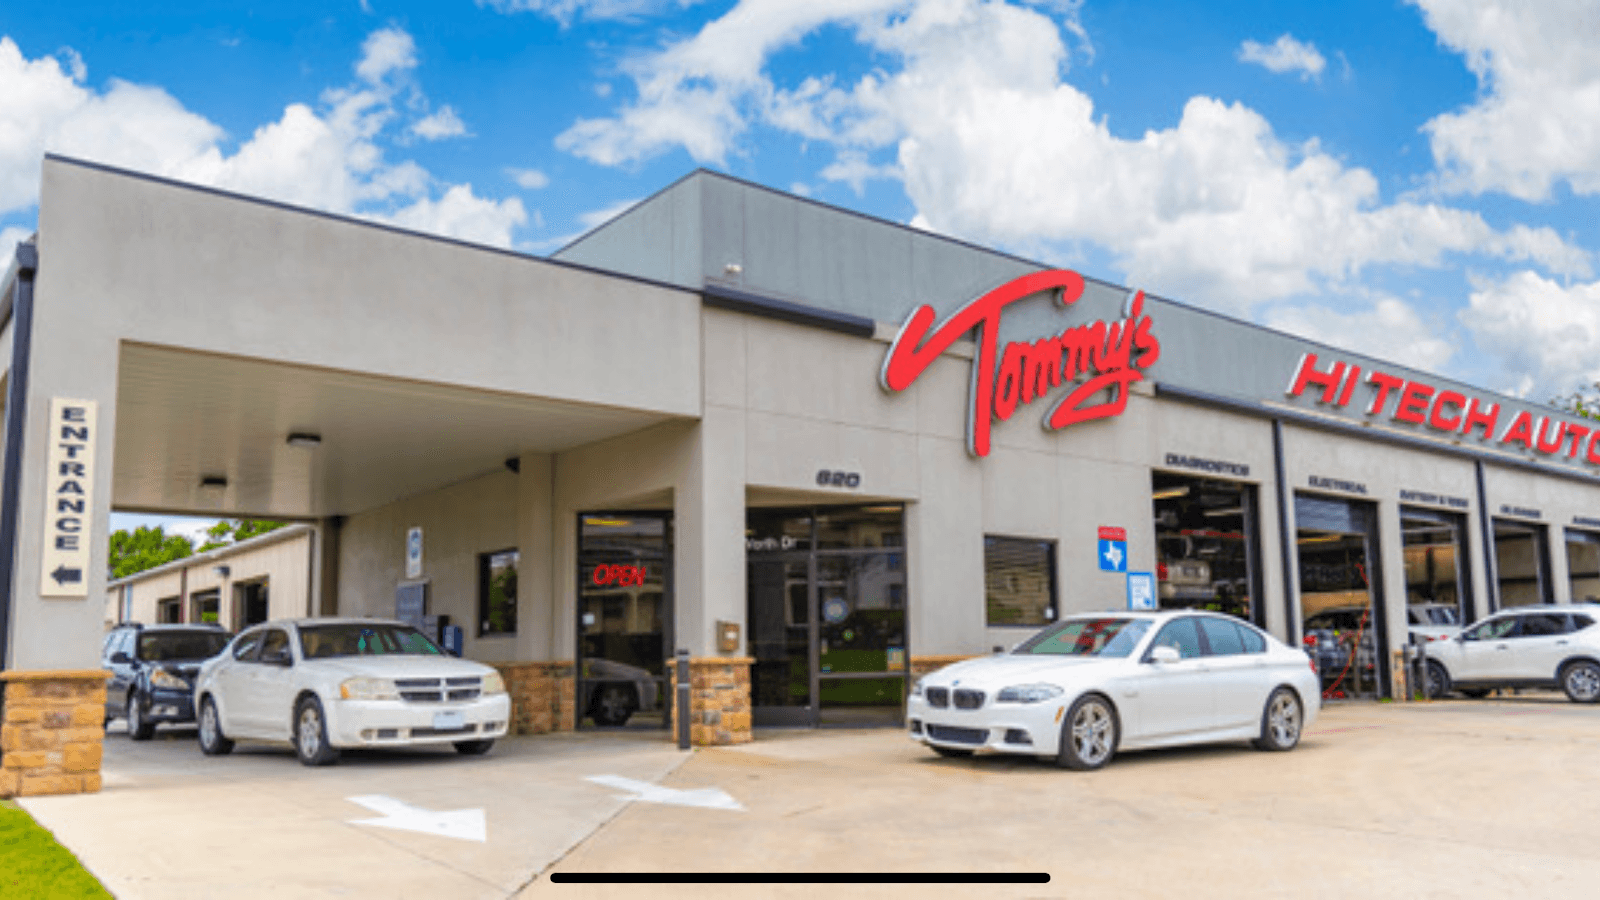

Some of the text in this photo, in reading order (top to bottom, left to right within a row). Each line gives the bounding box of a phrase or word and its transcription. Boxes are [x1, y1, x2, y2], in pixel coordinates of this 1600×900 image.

[881, 268, 1160, 457] Tommy's
[1287, 353, 1362, 408] HI
[1366, 371, 1499, 440] TECH
[55, 406, 88, 551] ENTRANCE
[593, 563, 646, 588] OPEN
